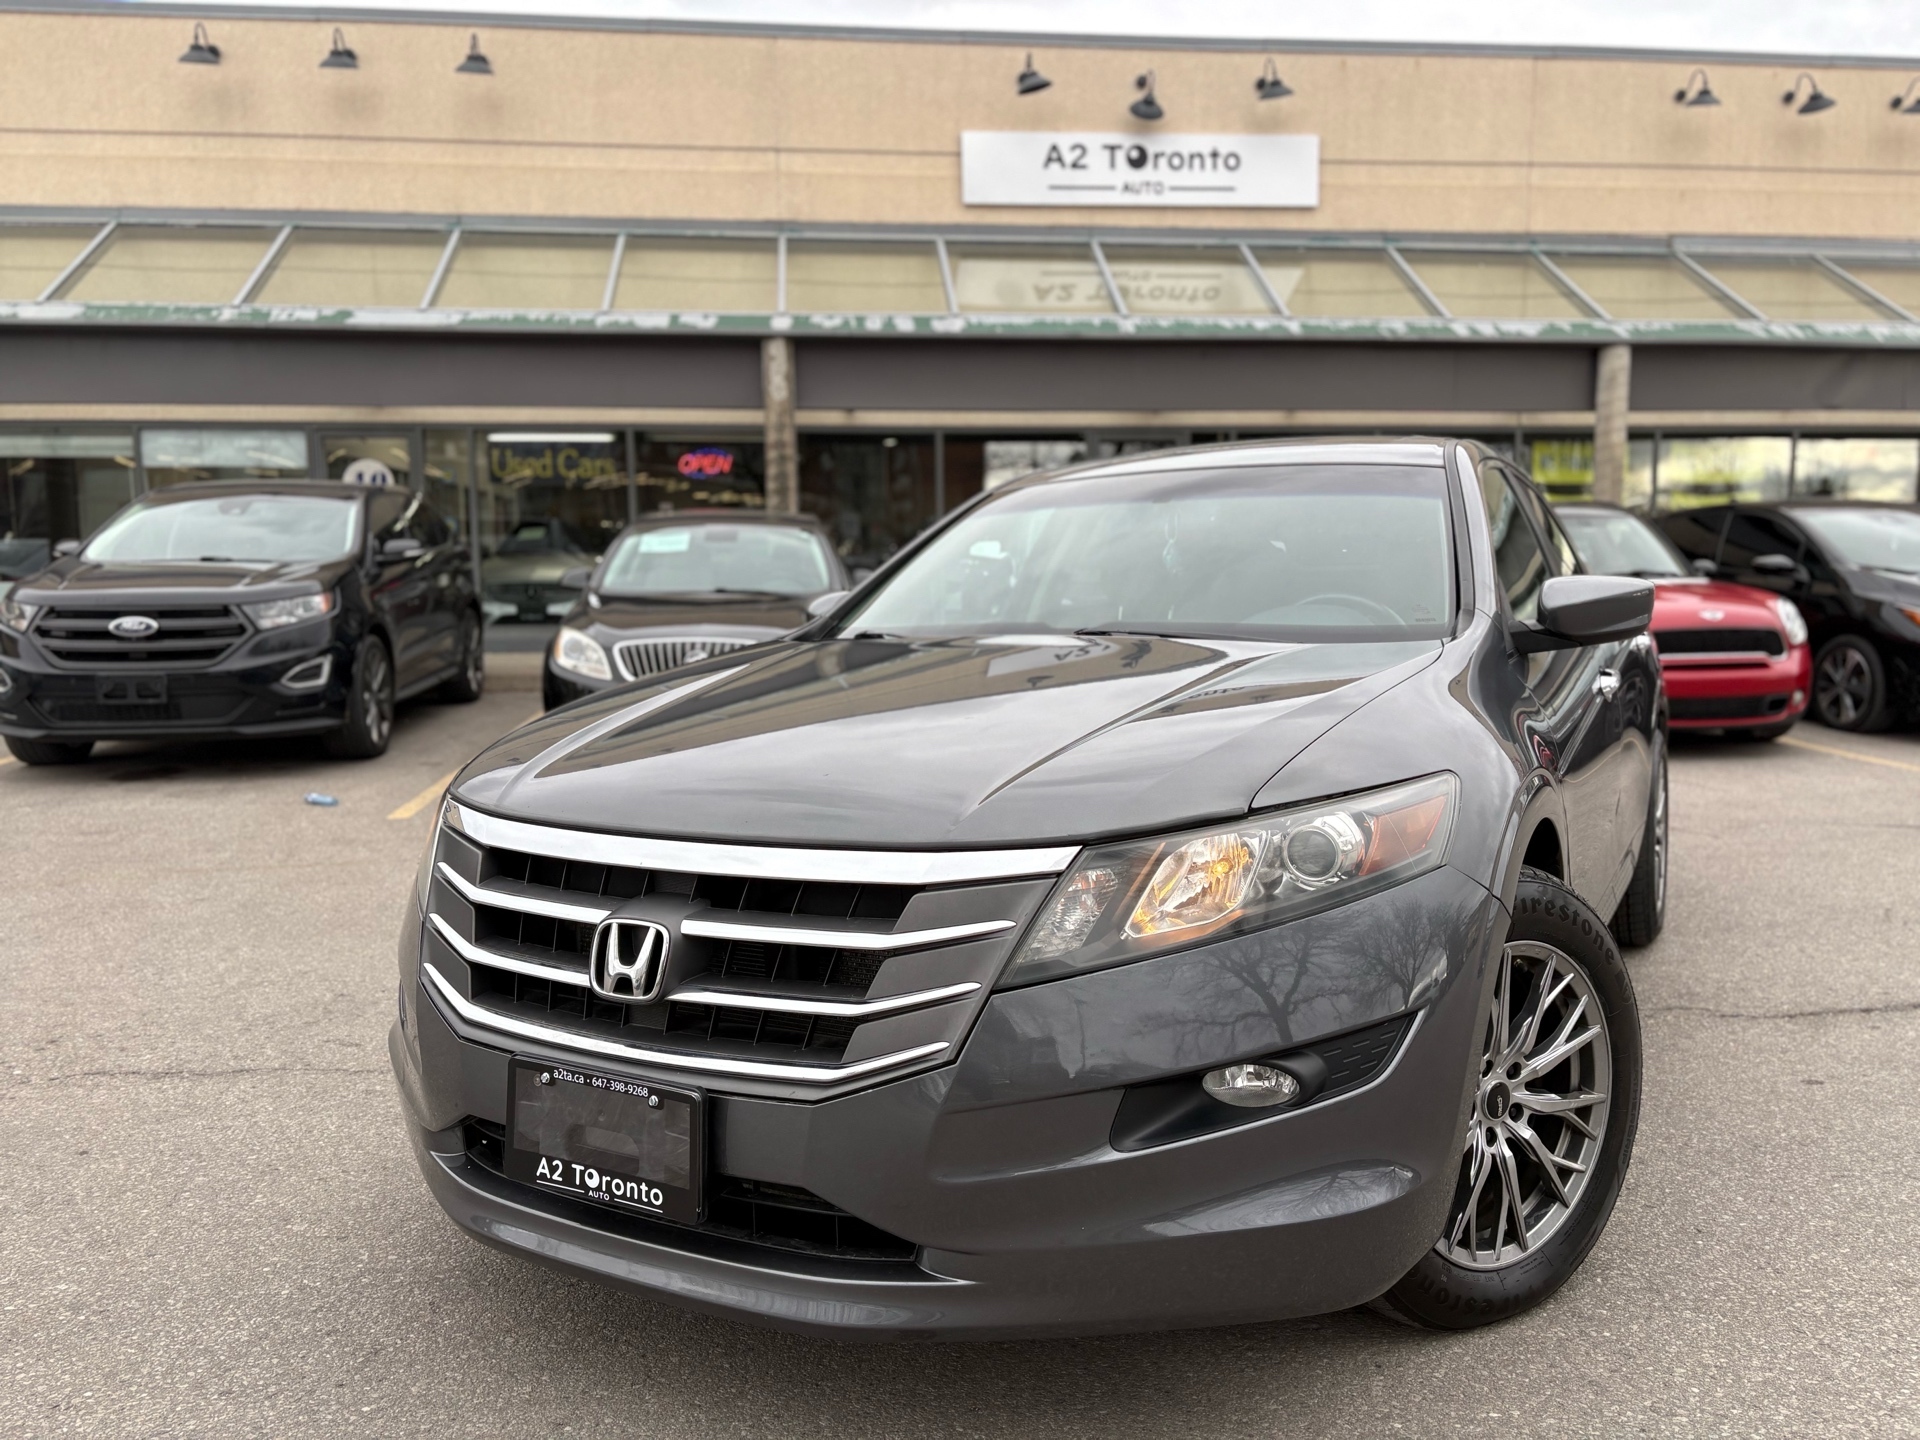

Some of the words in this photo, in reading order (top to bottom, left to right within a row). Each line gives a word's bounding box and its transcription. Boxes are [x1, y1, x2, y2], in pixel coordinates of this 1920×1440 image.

[1043, 144, 1088, 169] A2
[1121, 180, 1165, 195] AUTO
[491, 448, 554, 478] Used
[556, 447, 615, 478] Cars
[677, 453, 734, 475] OPEN
[1513, 895, 1615, 965] irestone
[553, 1069, 584, 1083] a2ta.ca
[592, 1077, 649, 1097] 647-398-9268
[536, 1157, 563, 1181] A2
[588, 1189, 610, 1201] AUTO
